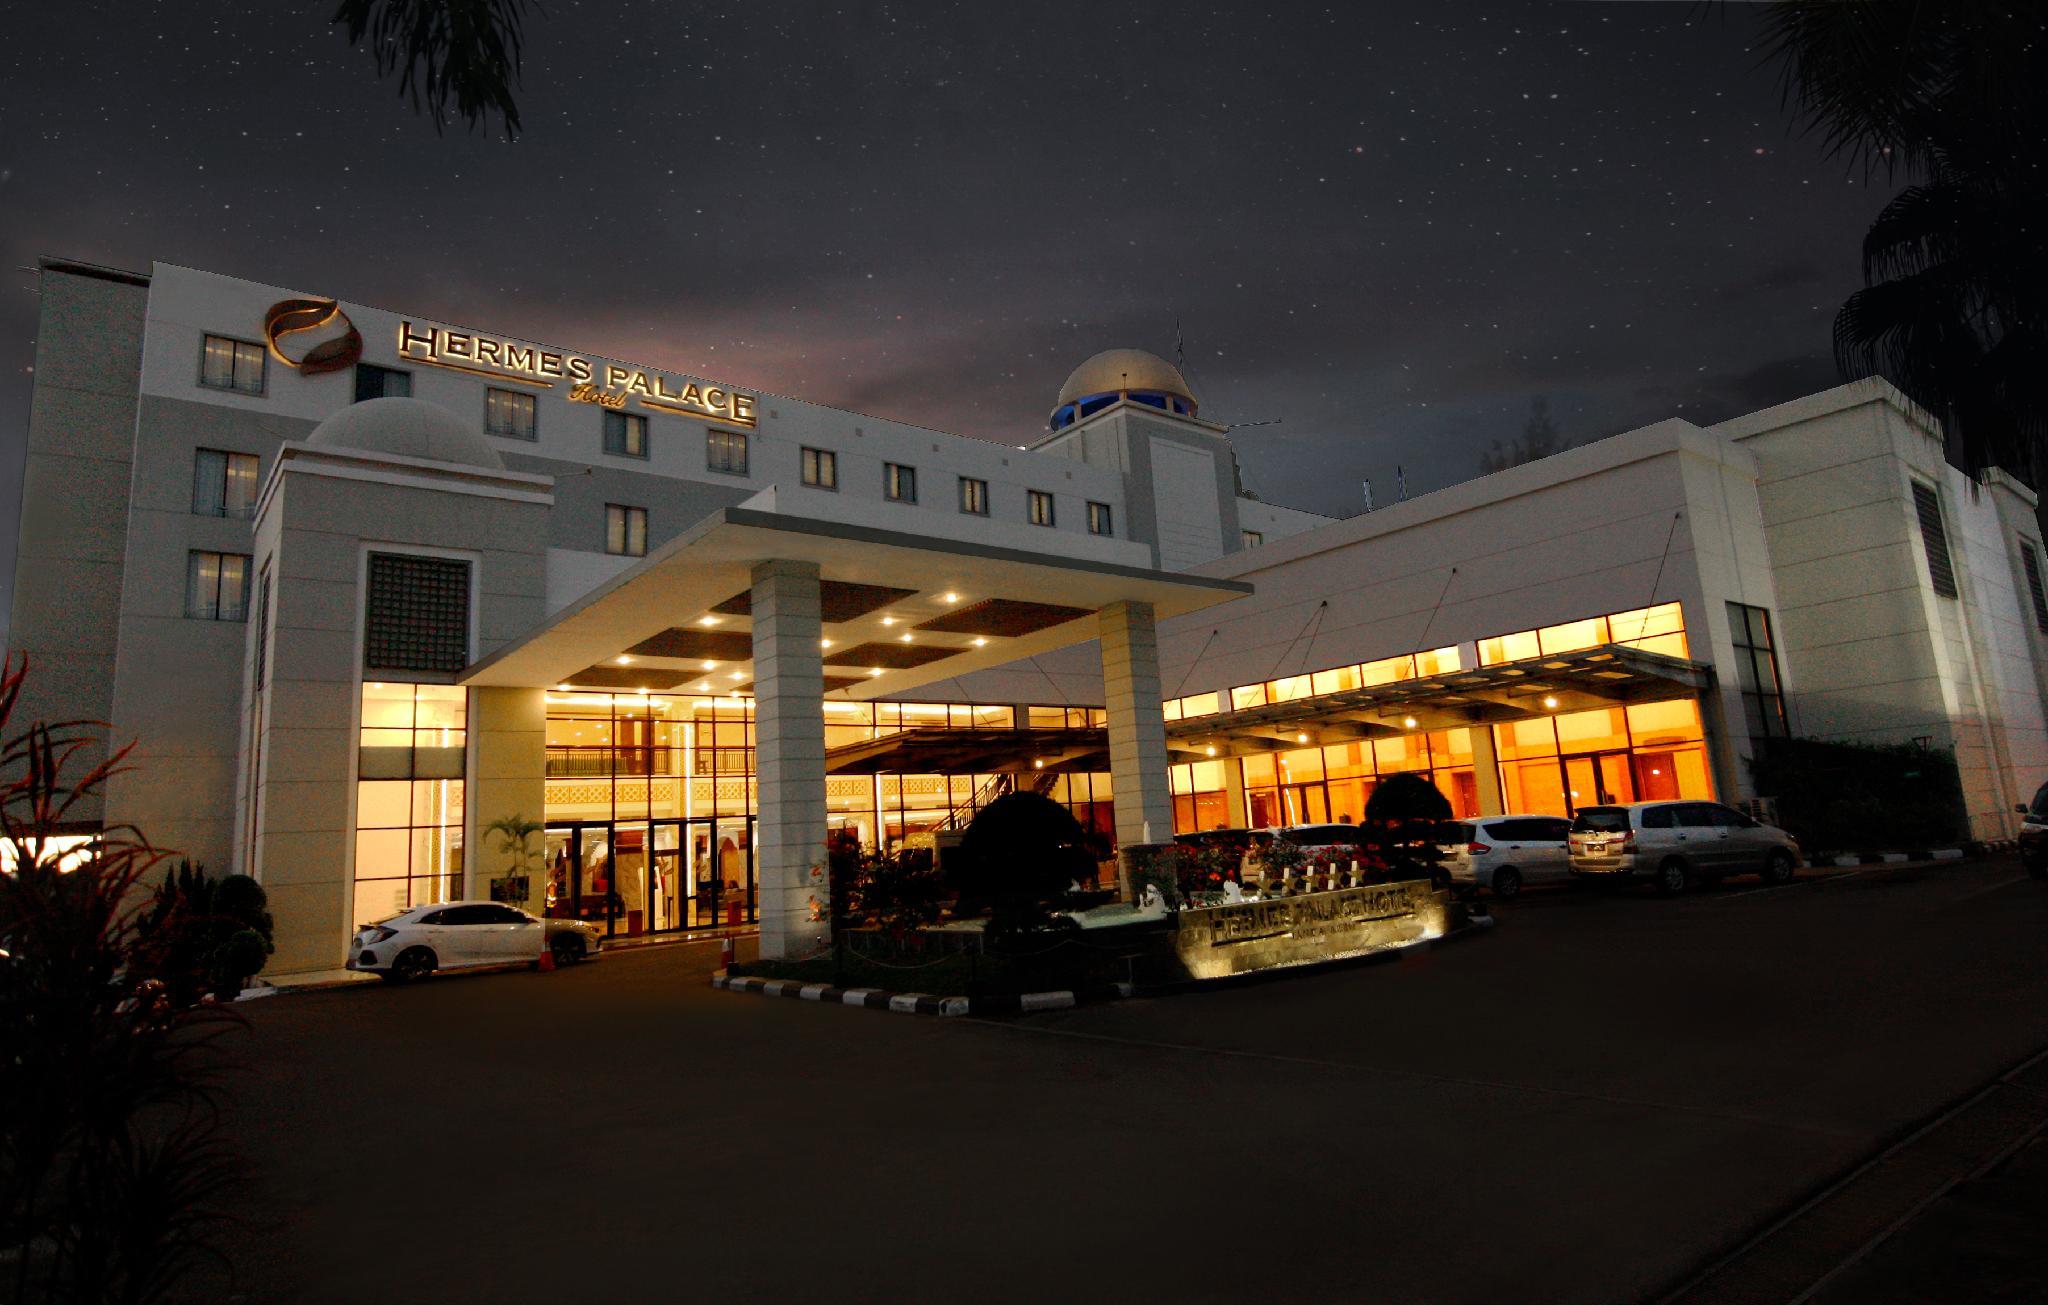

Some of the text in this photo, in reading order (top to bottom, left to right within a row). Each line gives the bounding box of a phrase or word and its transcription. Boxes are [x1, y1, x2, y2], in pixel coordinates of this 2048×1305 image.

[399, 320, 757, 422] HERMES PALACE
[569, 383, 628, 409] Hotel
